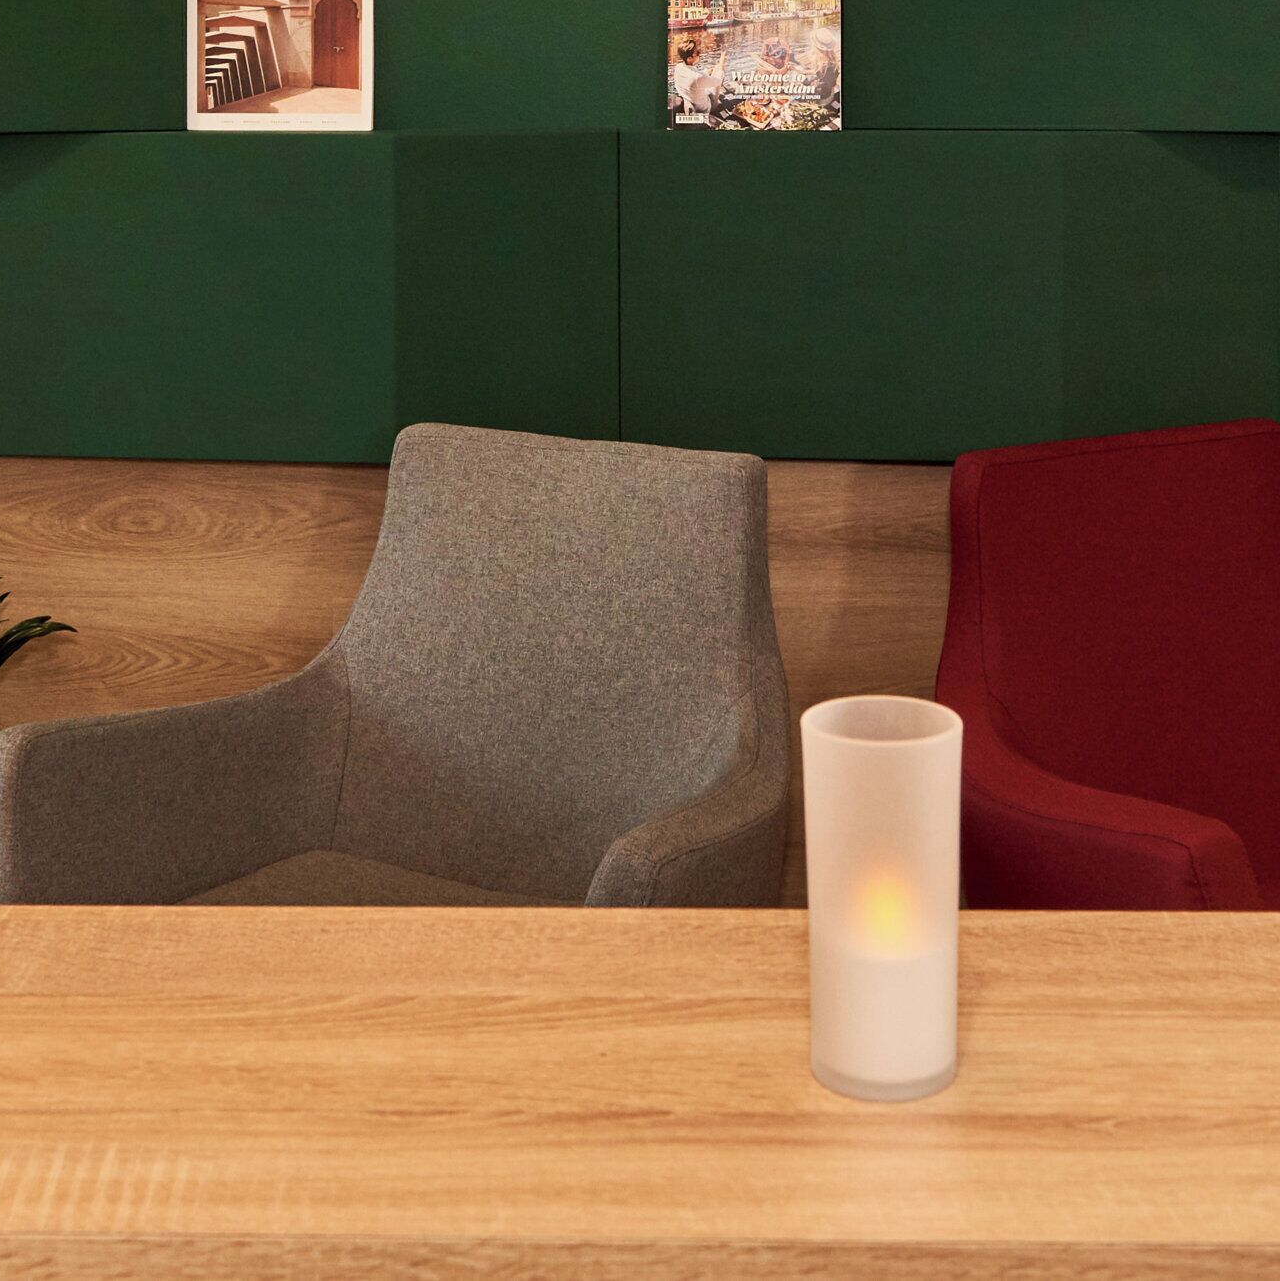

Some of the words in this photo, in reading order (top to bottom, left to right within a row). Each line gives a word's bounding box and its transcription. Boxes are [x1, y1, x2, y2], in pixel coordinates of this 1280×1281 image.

[731, 70, 789, 83] Welcome
[791, 71, 806, 83] to
[735, 83, 816, 94] Amsterdam
